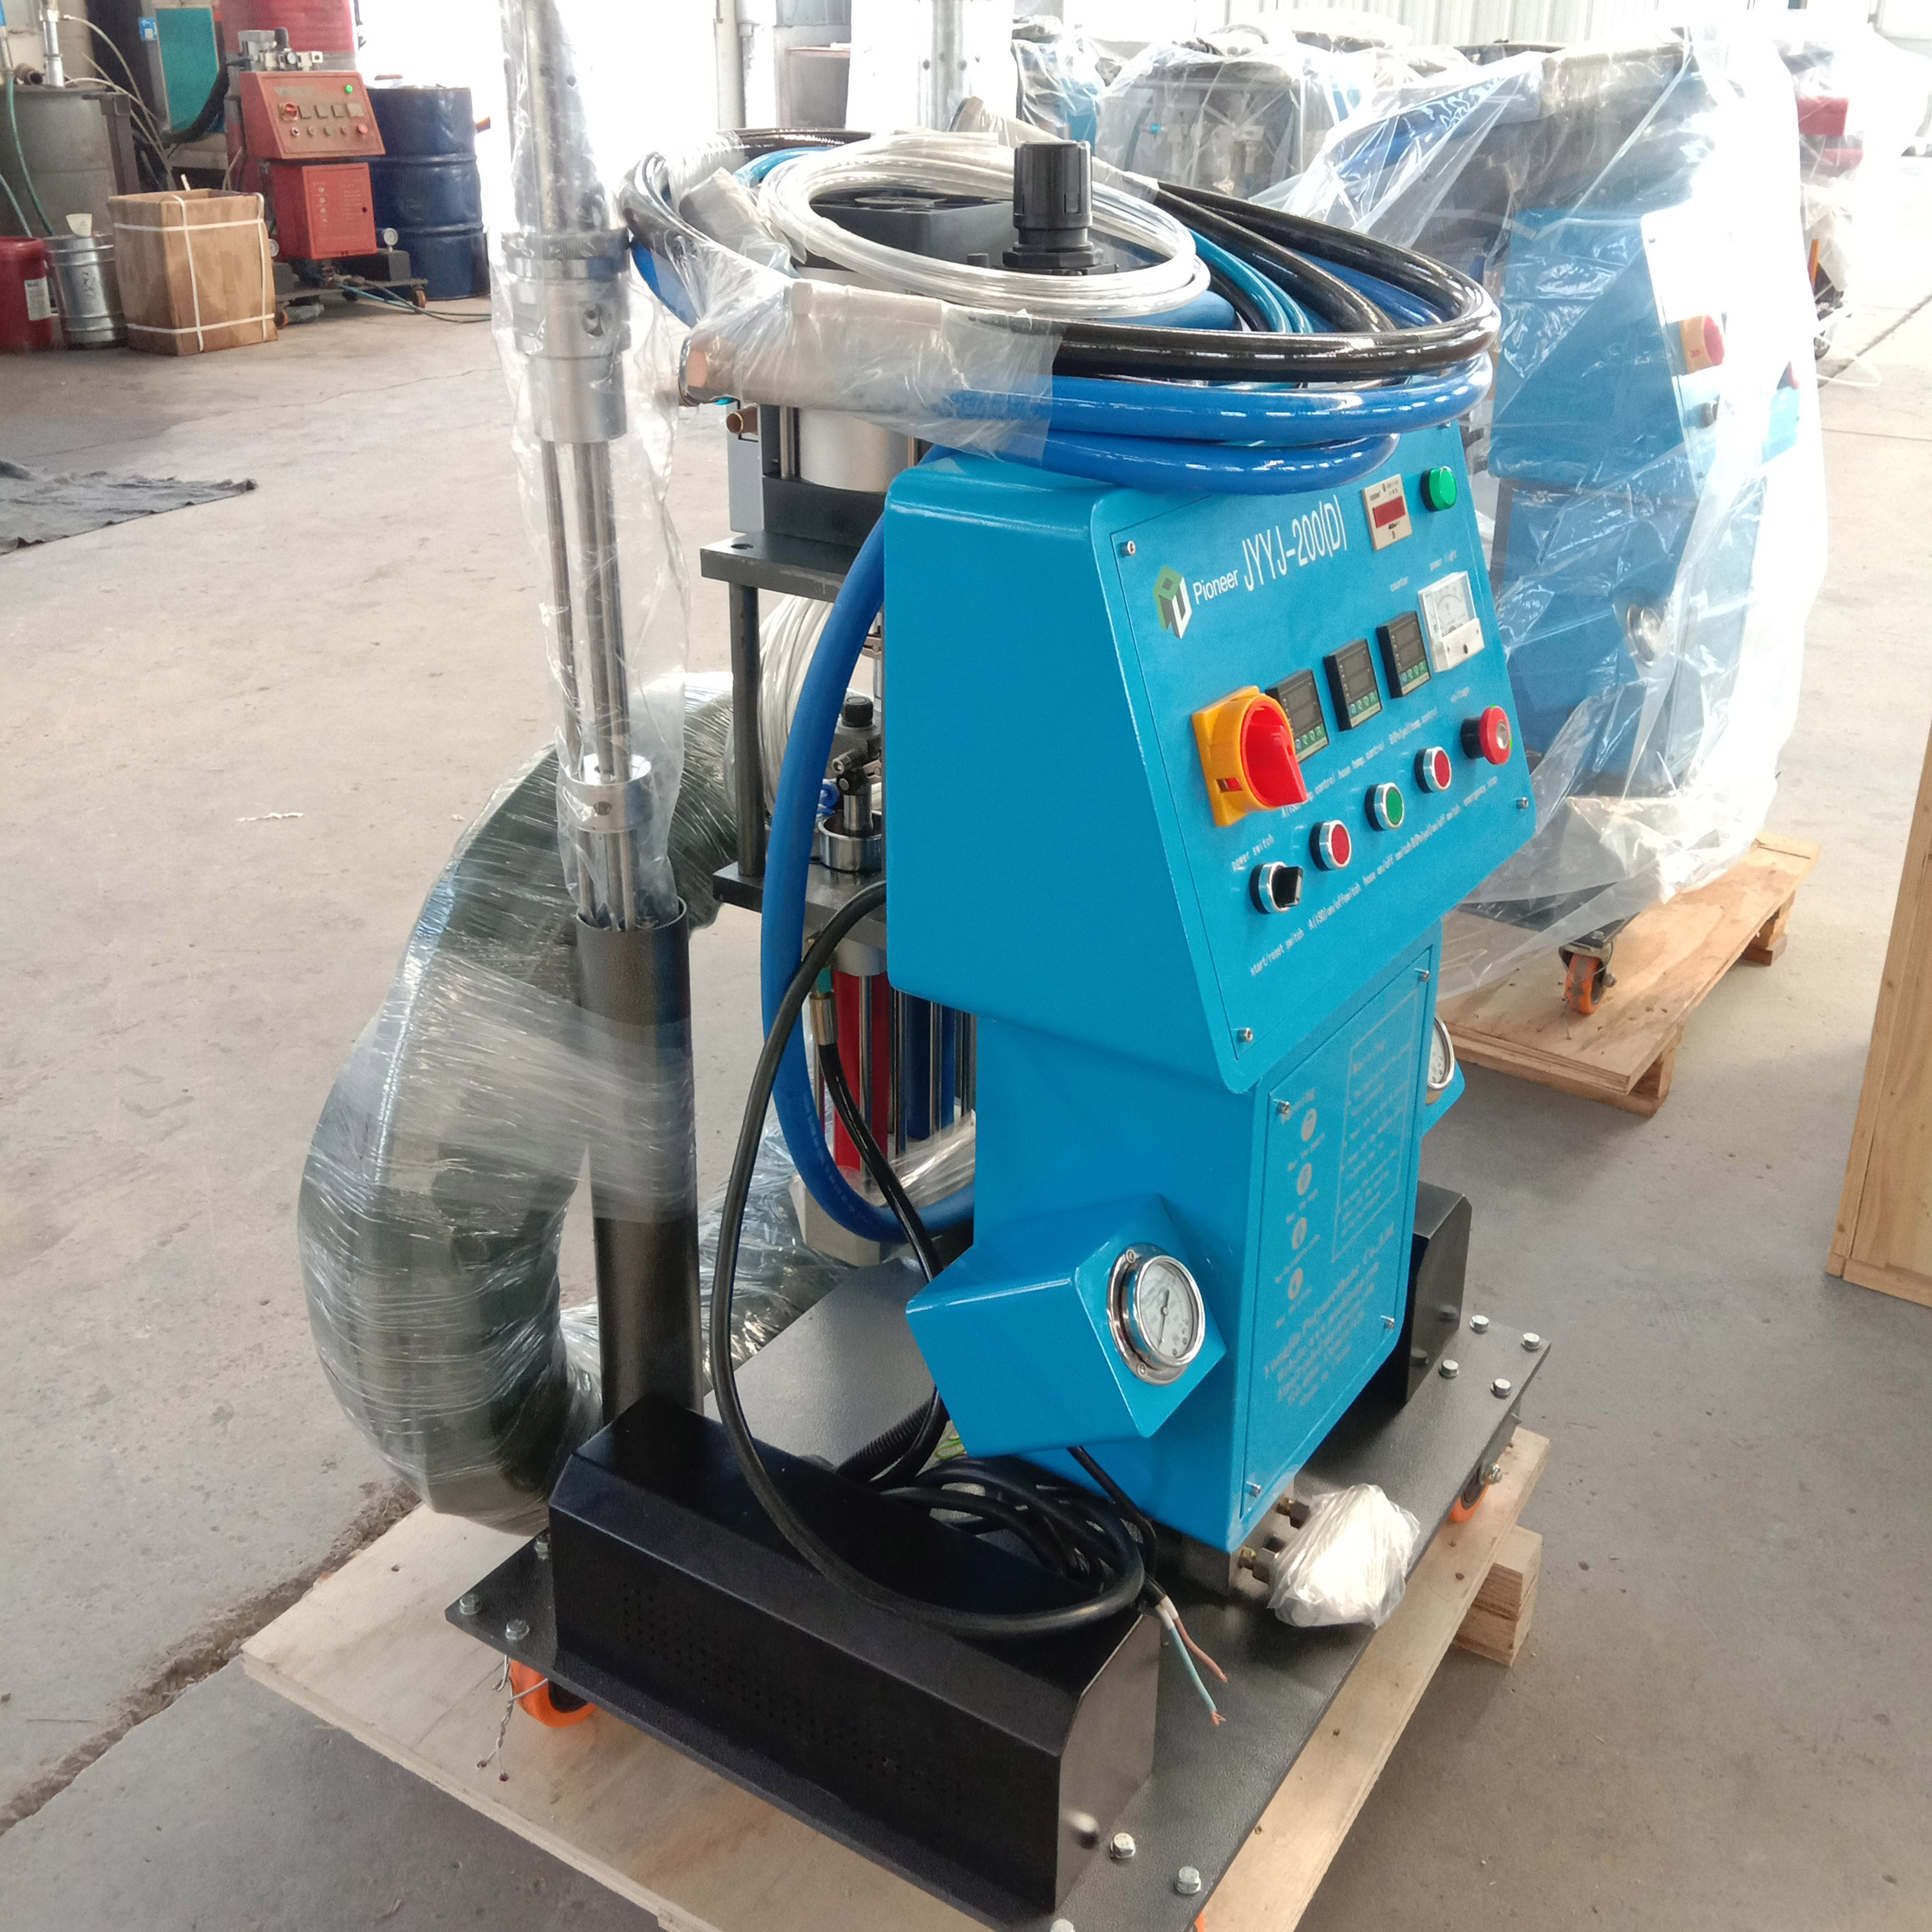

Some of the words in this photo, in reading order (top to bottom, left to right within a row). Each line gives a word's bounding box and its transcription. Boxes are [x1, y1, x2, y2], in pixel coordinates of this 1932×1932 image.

[1193, 570, 1238, 605] Pioneer
[1242, 494, 1347, 591] JYYJ-200(D)
[1252, 833, 1275, 857] switch
